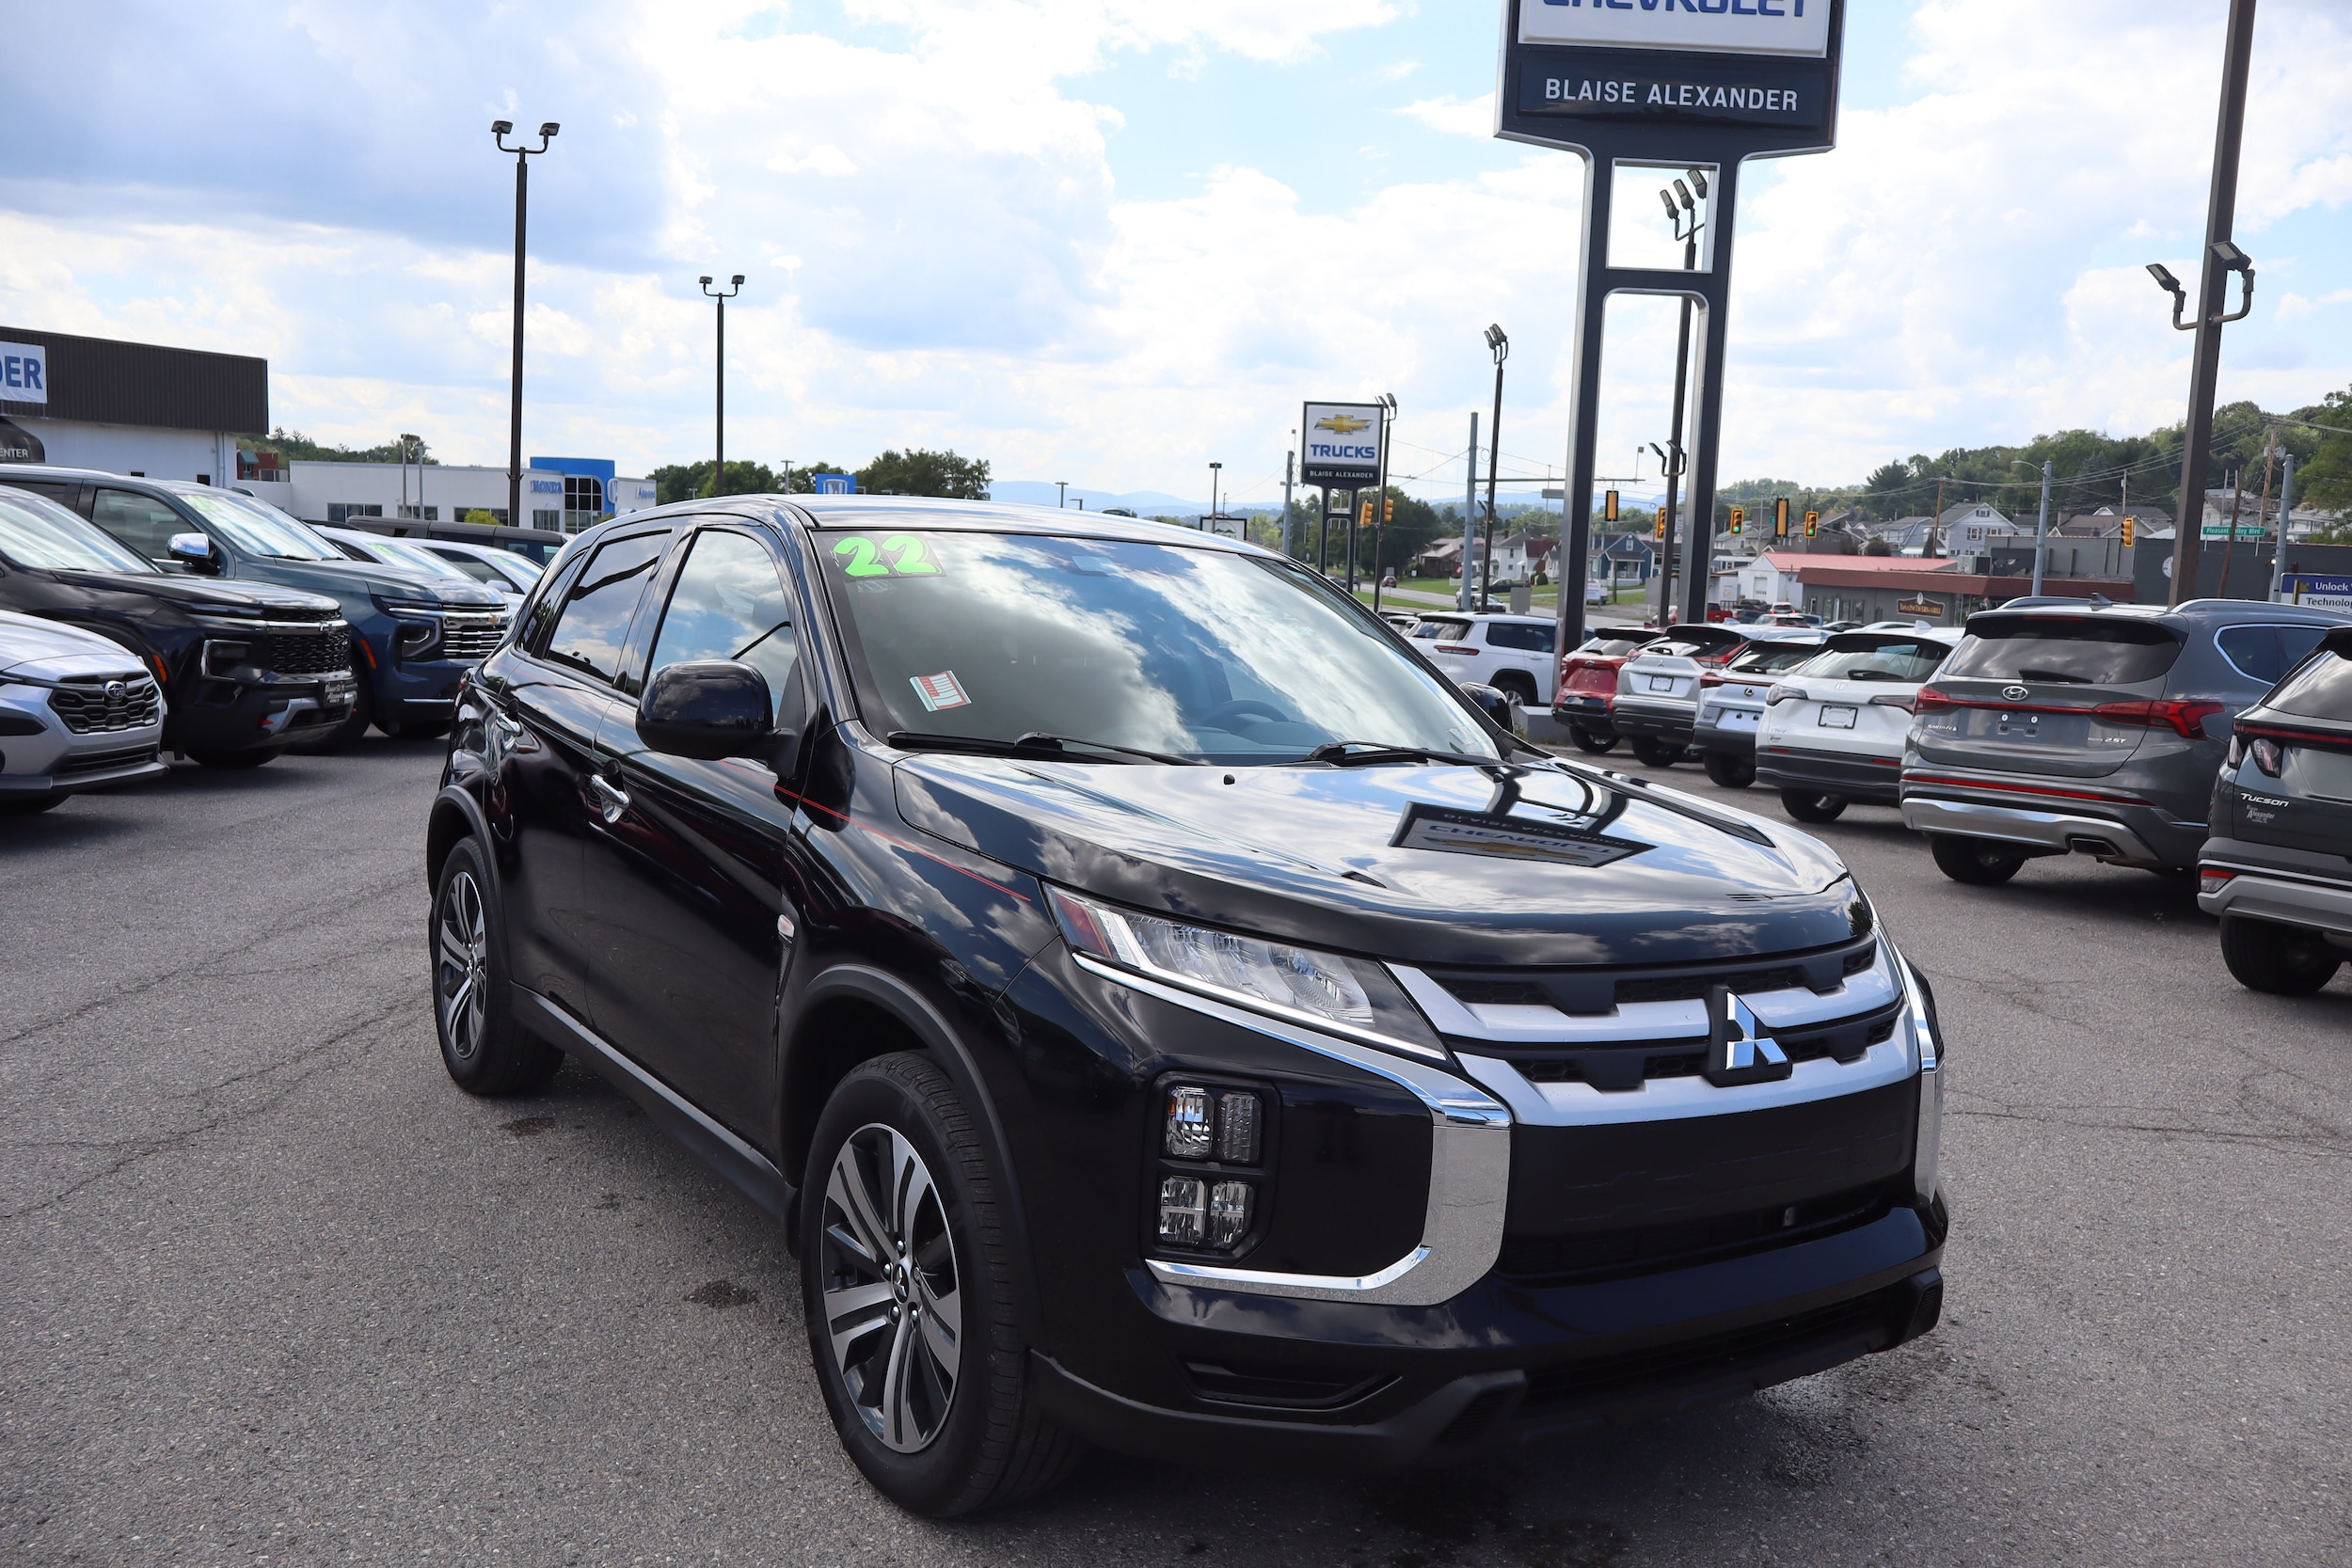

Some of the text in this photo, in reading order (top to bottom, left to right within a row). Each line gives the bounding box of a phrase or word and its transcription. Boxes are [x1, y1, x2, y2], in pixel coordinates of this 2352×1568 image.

[1545, 78, 1798, 111] BLAISE ALEXANDER
[0, 356, 42, 389] ER
[1311, 444, 1375, 459] TRUCKS
[532, 480, 564, 493] HONDA
[833, 534, 942, 577] 22
[2315, 581, 2349, 592] Unlock
[2240, 792, 2289, 807] TUCSON
